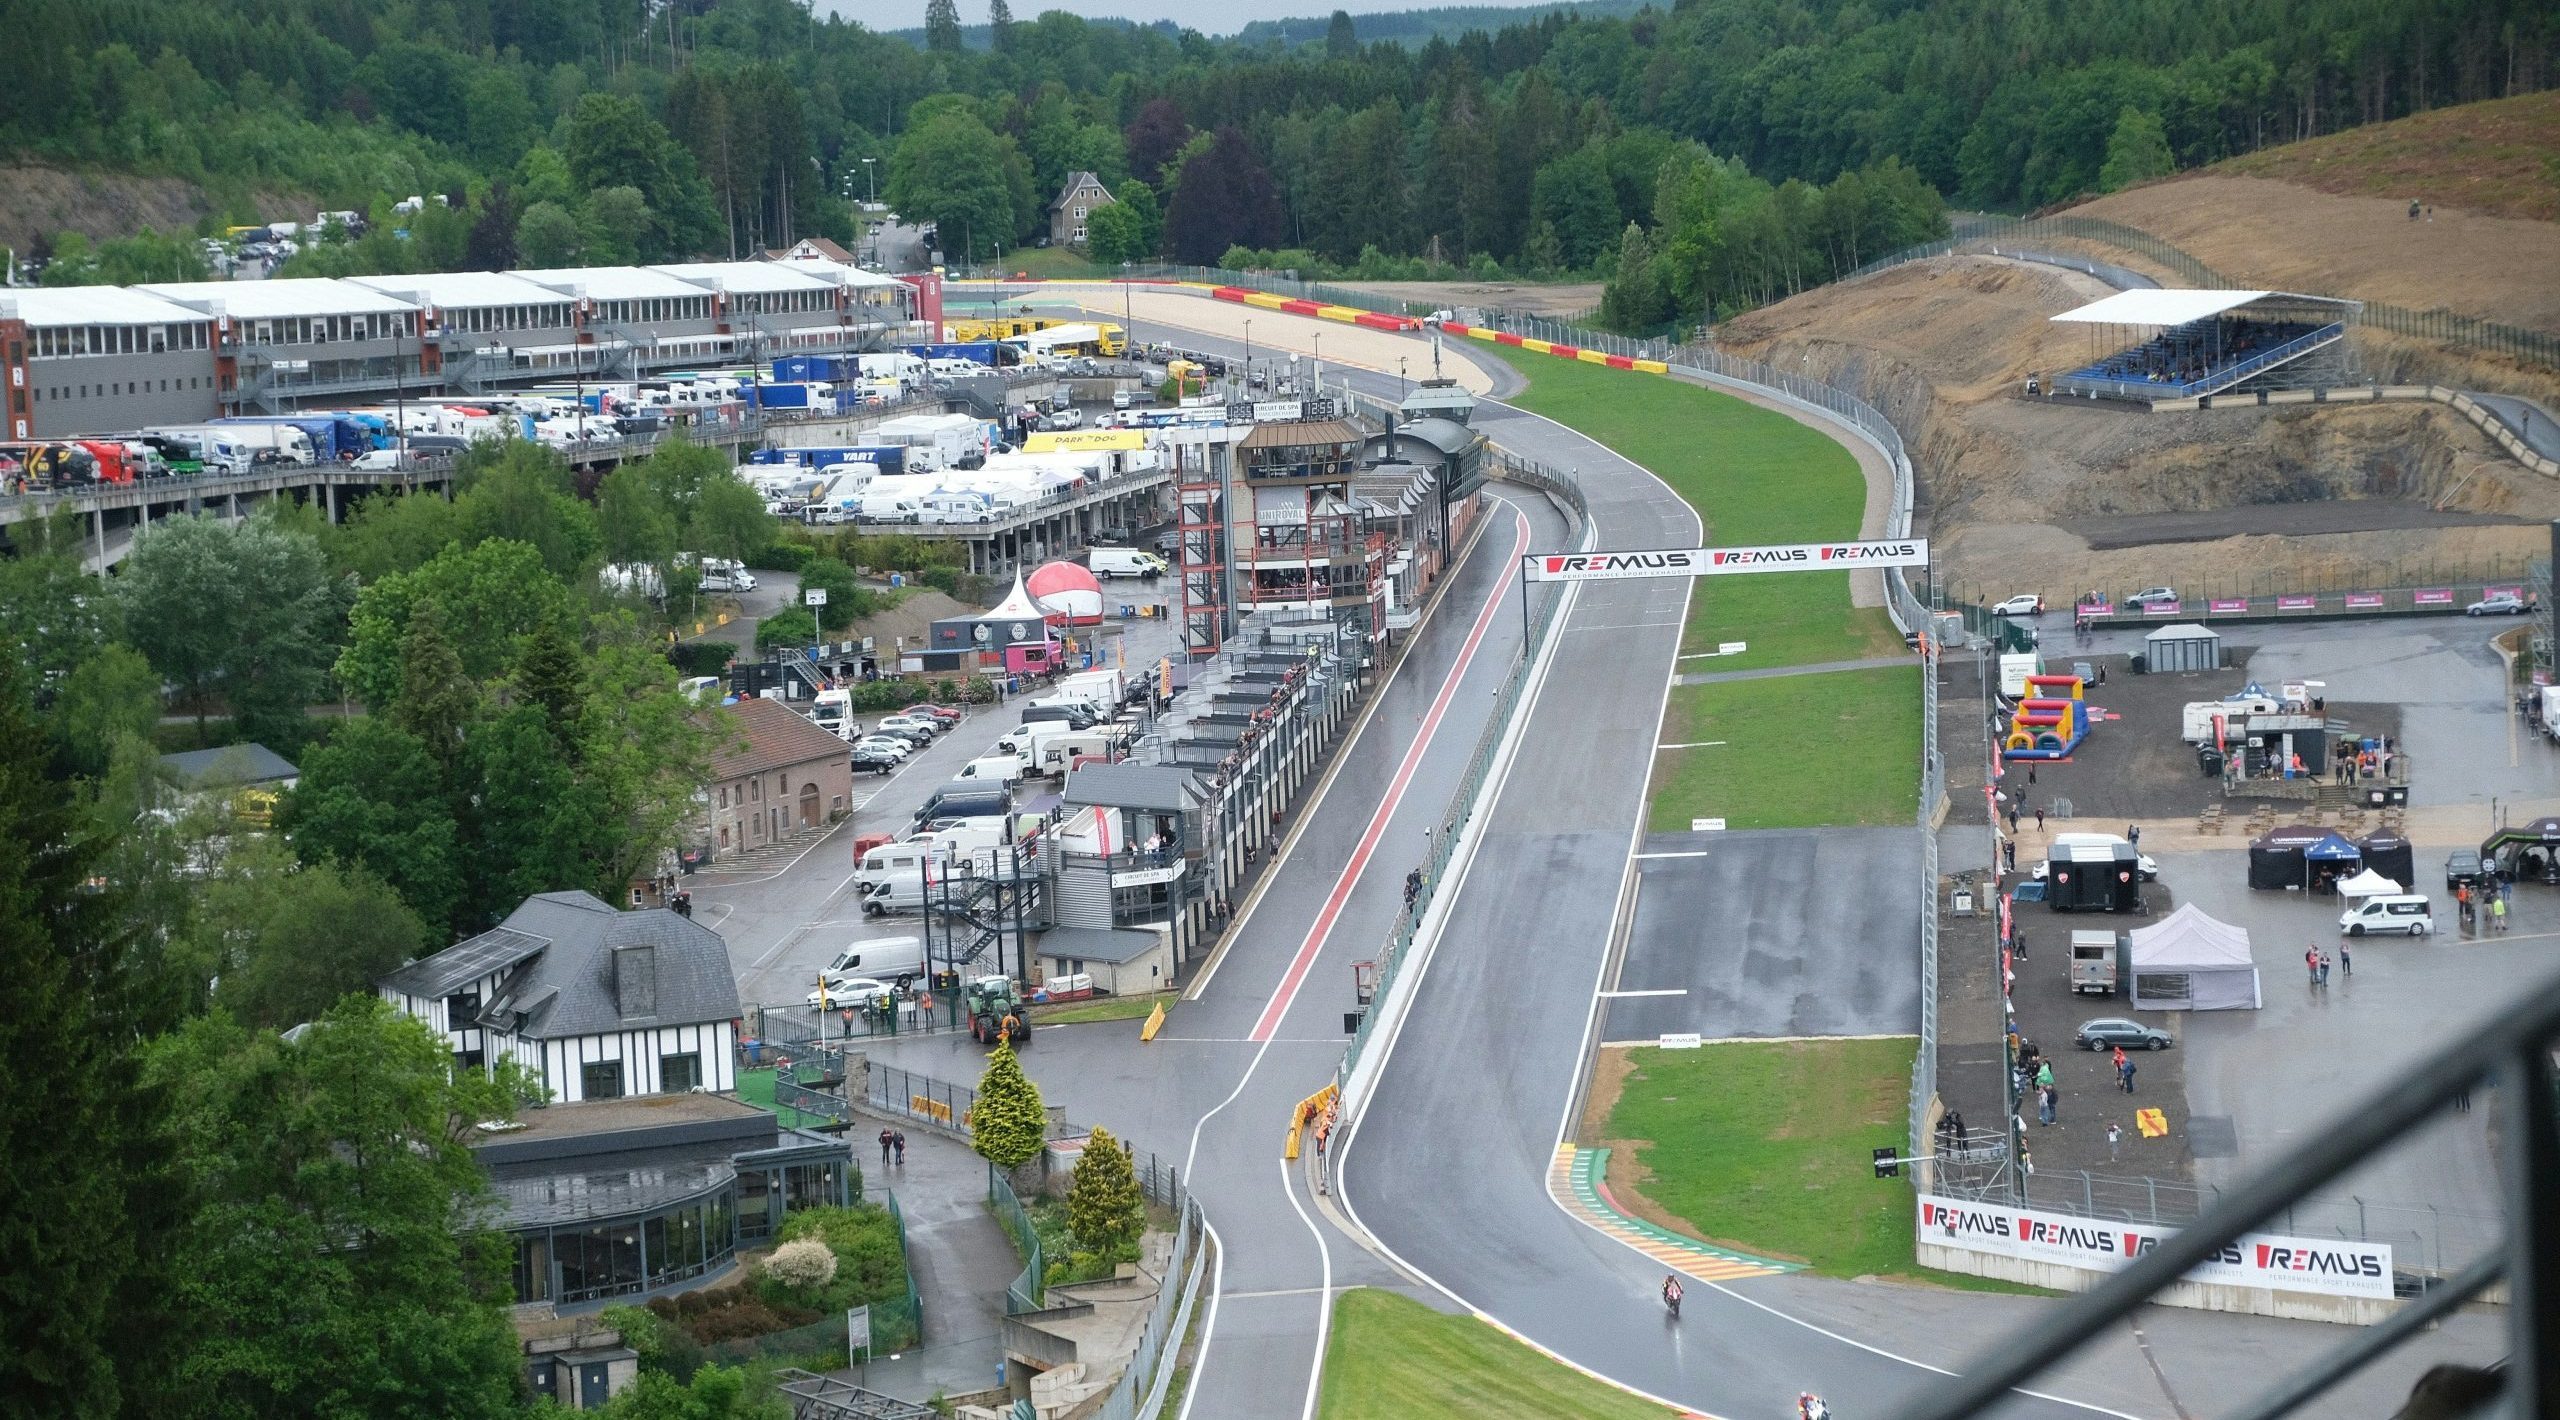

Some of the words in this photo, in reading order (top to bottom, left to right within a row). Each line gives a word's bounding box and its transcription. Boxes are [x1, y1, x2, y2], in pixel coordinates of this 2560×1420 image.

[1255, 404, 1277, 412] CIRCUIT
[843, 452, 876, 461] YART
[1259, 509, 1305, 520] UNIROYAL
[1725, 549, 1808, 564] REMUS
[1832, 544, 1916, 559] REMUS
[1562, 553, 1691, 571] REMUS
[1933, 1206, 2010, 1237] REMUS
[2031, 1221, 2115, 1252] REMUS
[2269, 1247, 2382, 1278] REMUS
